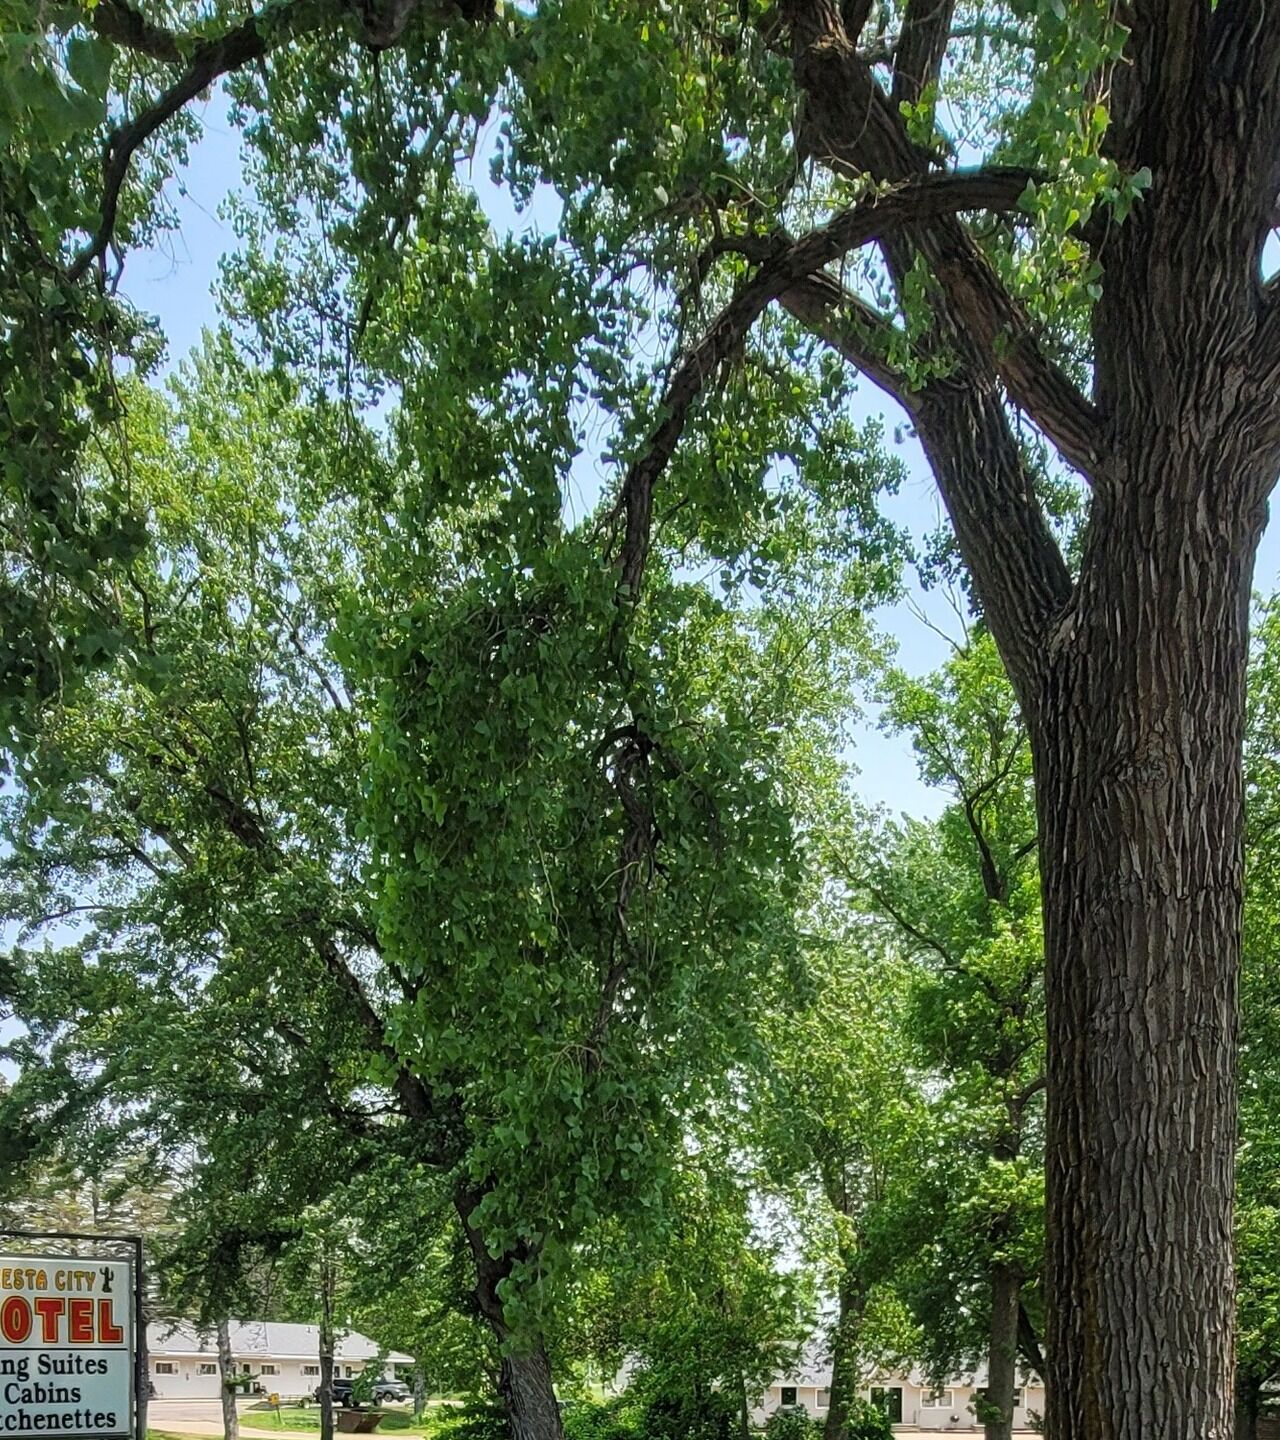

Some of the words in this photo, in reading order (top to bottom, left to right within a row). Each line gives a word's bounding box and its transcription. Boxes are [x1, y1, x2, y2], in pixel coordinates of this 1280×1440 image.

[55, 1270, 96, 1291] CITY
[37, 1354, 108, 1375] Suites
[4, 1382, 82, 1405] Cabins
